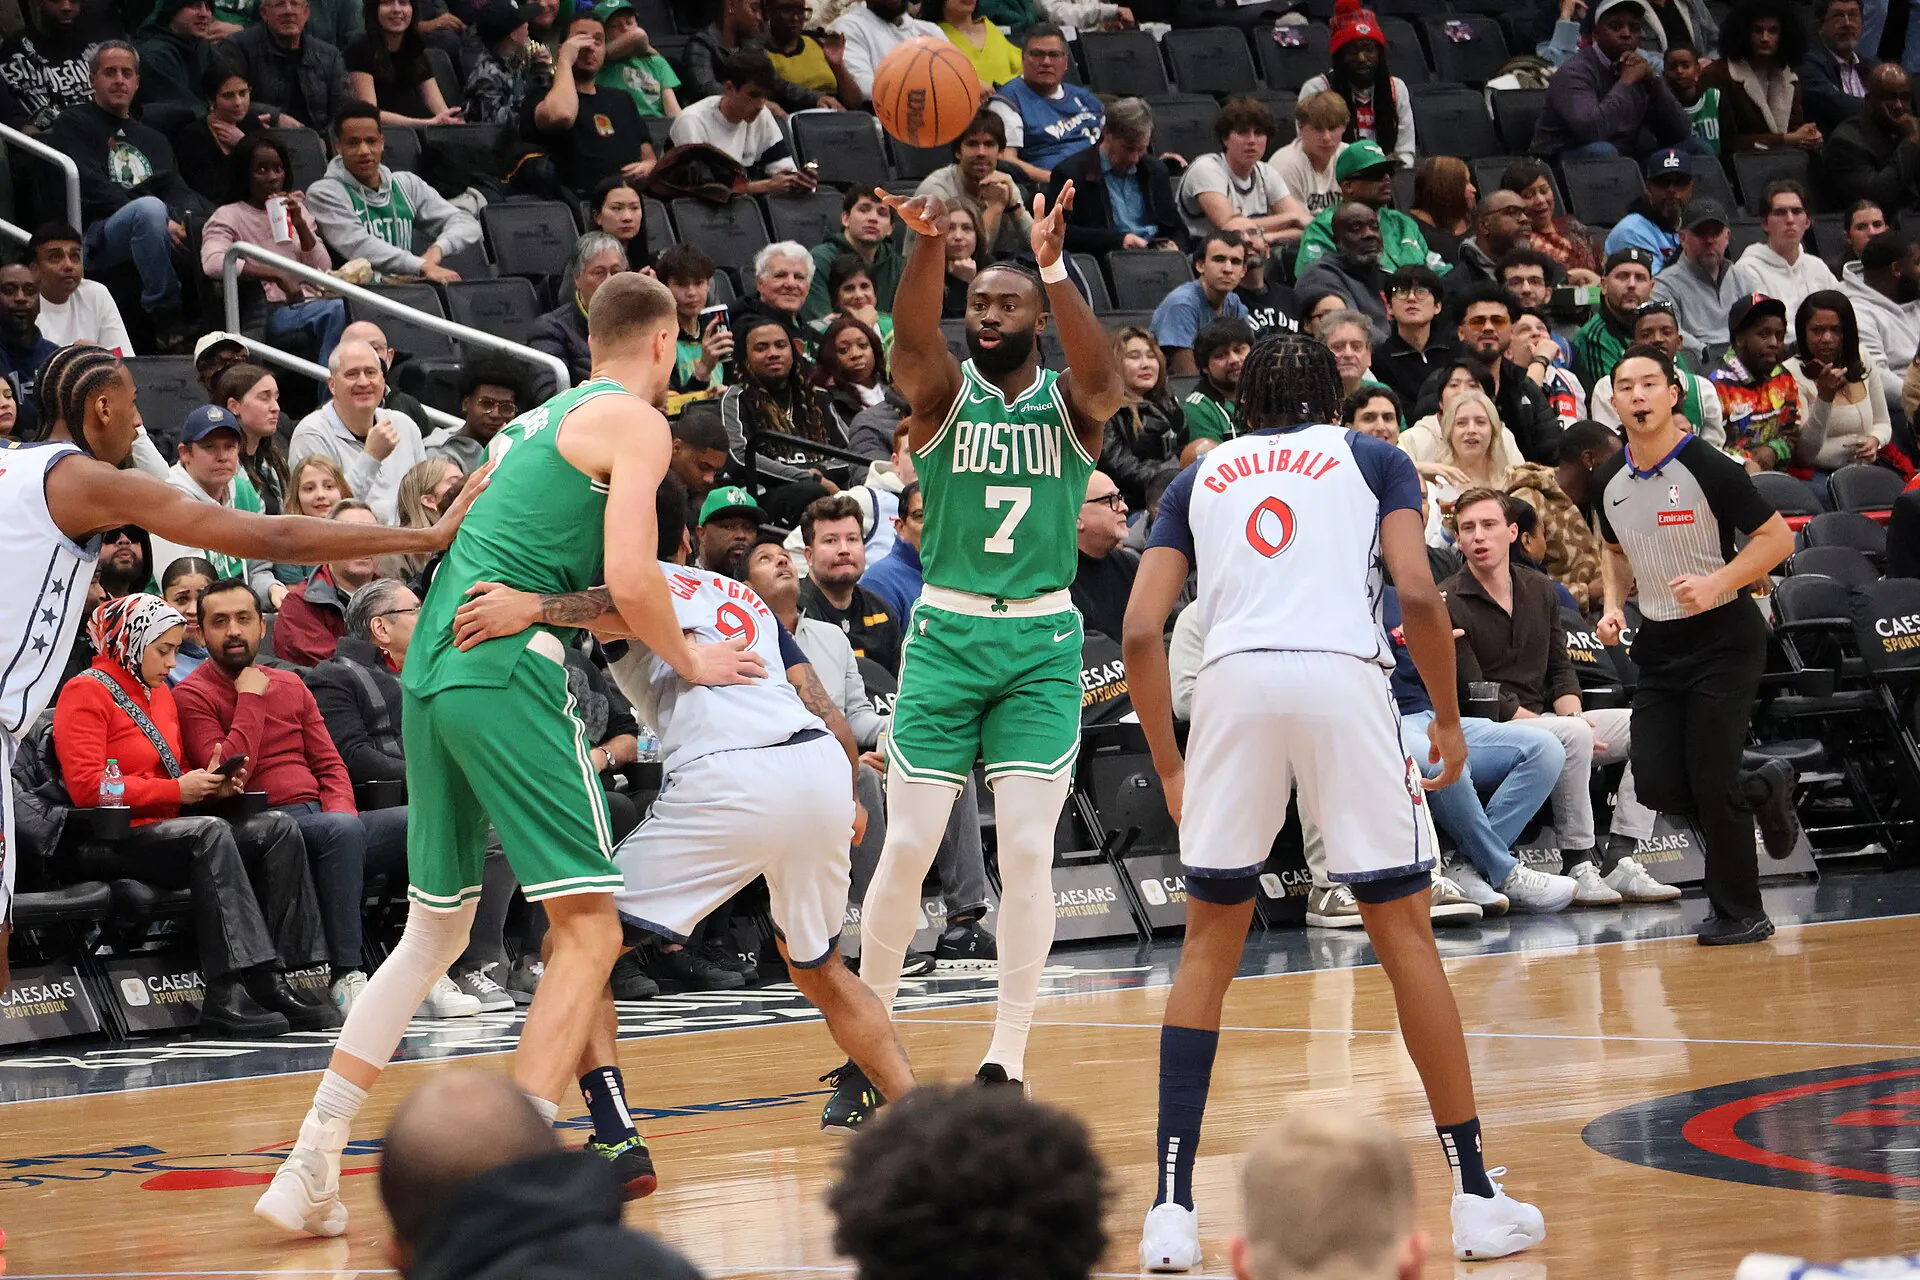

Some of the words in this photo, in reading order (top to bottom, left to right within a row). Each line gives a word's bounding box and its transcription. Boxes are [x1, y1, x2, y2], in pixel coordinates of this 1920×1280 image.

[1020, 402, 1053, 413] Amica
[952, 421, 1061, 479] BOSTON
[1203, 449, 1341, 494] COULIBALY
[984, 485, 1032, 554] 7
[1245, 495, 1298, 559] 0
[1658, 513, 1694, 524] Emirates
[714, 601, 760, 652] 9
[1875, 614, 1920, 637] CAES
[1080, 660, 1125, 690] ESAR
[1632, 833, 1690, 854] AESARS
[1518, 848, 1563, 864] AESAR
[147, 971, 207, 992] CAESA
[152, 988, 207, 1005] SPORTSBO
[3, 1000, 69, 1020] SPORTSBOOK
